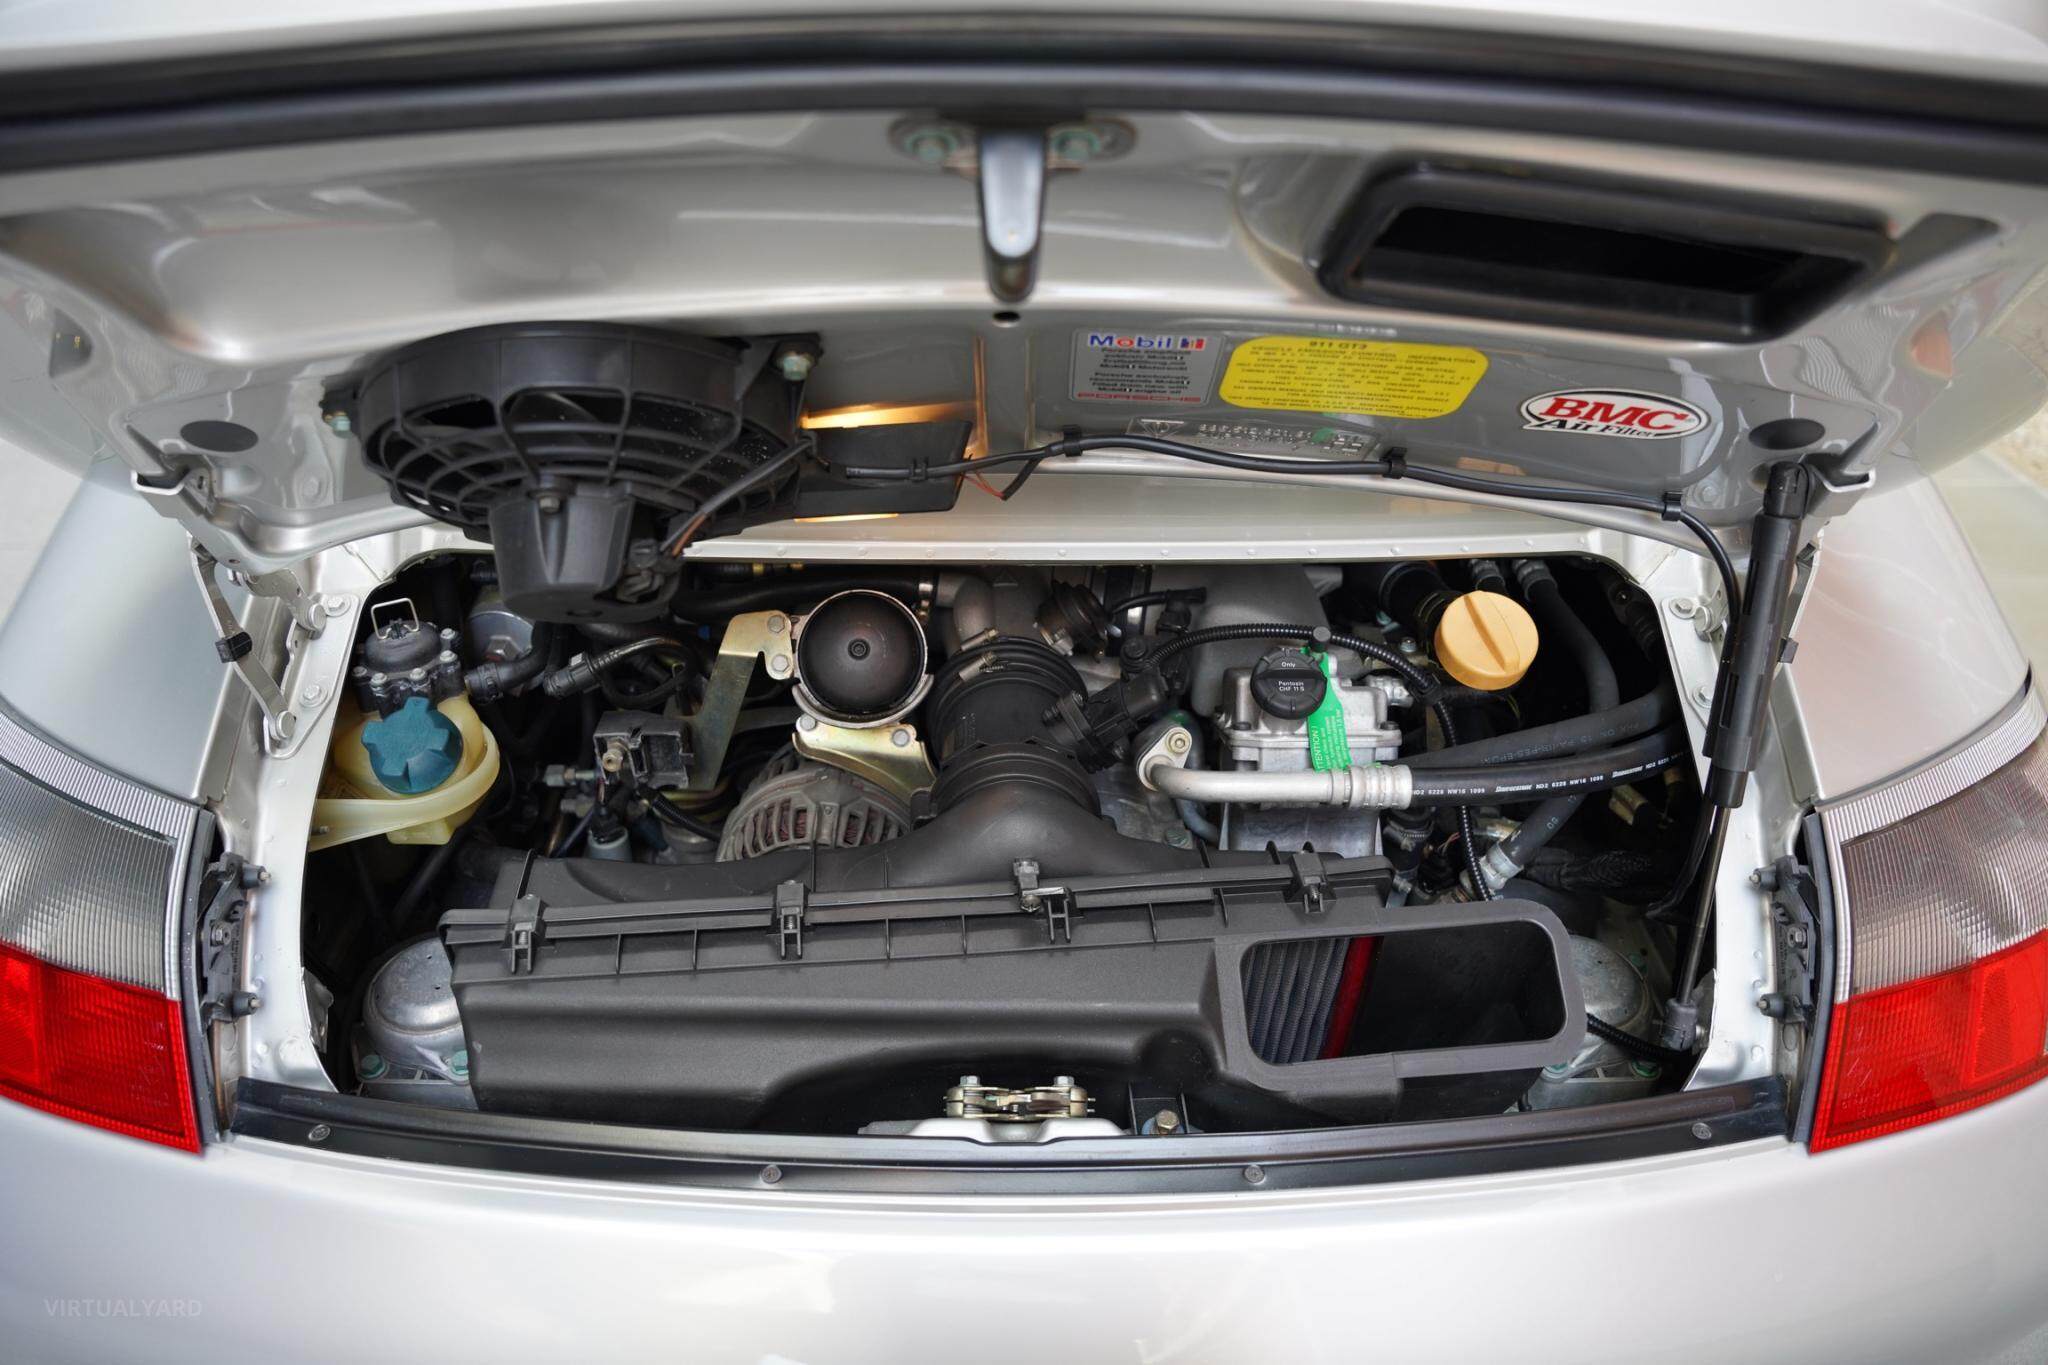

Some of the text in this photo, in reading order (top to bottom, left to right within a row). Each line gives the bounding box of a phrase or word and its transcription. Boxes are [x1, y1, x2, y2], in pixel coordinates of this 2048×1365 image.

[1089, 335, 1172, 349] Mobil
[1539, 397, 1690, 431] BMC
[1534, 419, 1656, 438] Air Filter
[1311, 729, 1324, 769] TTENTION
